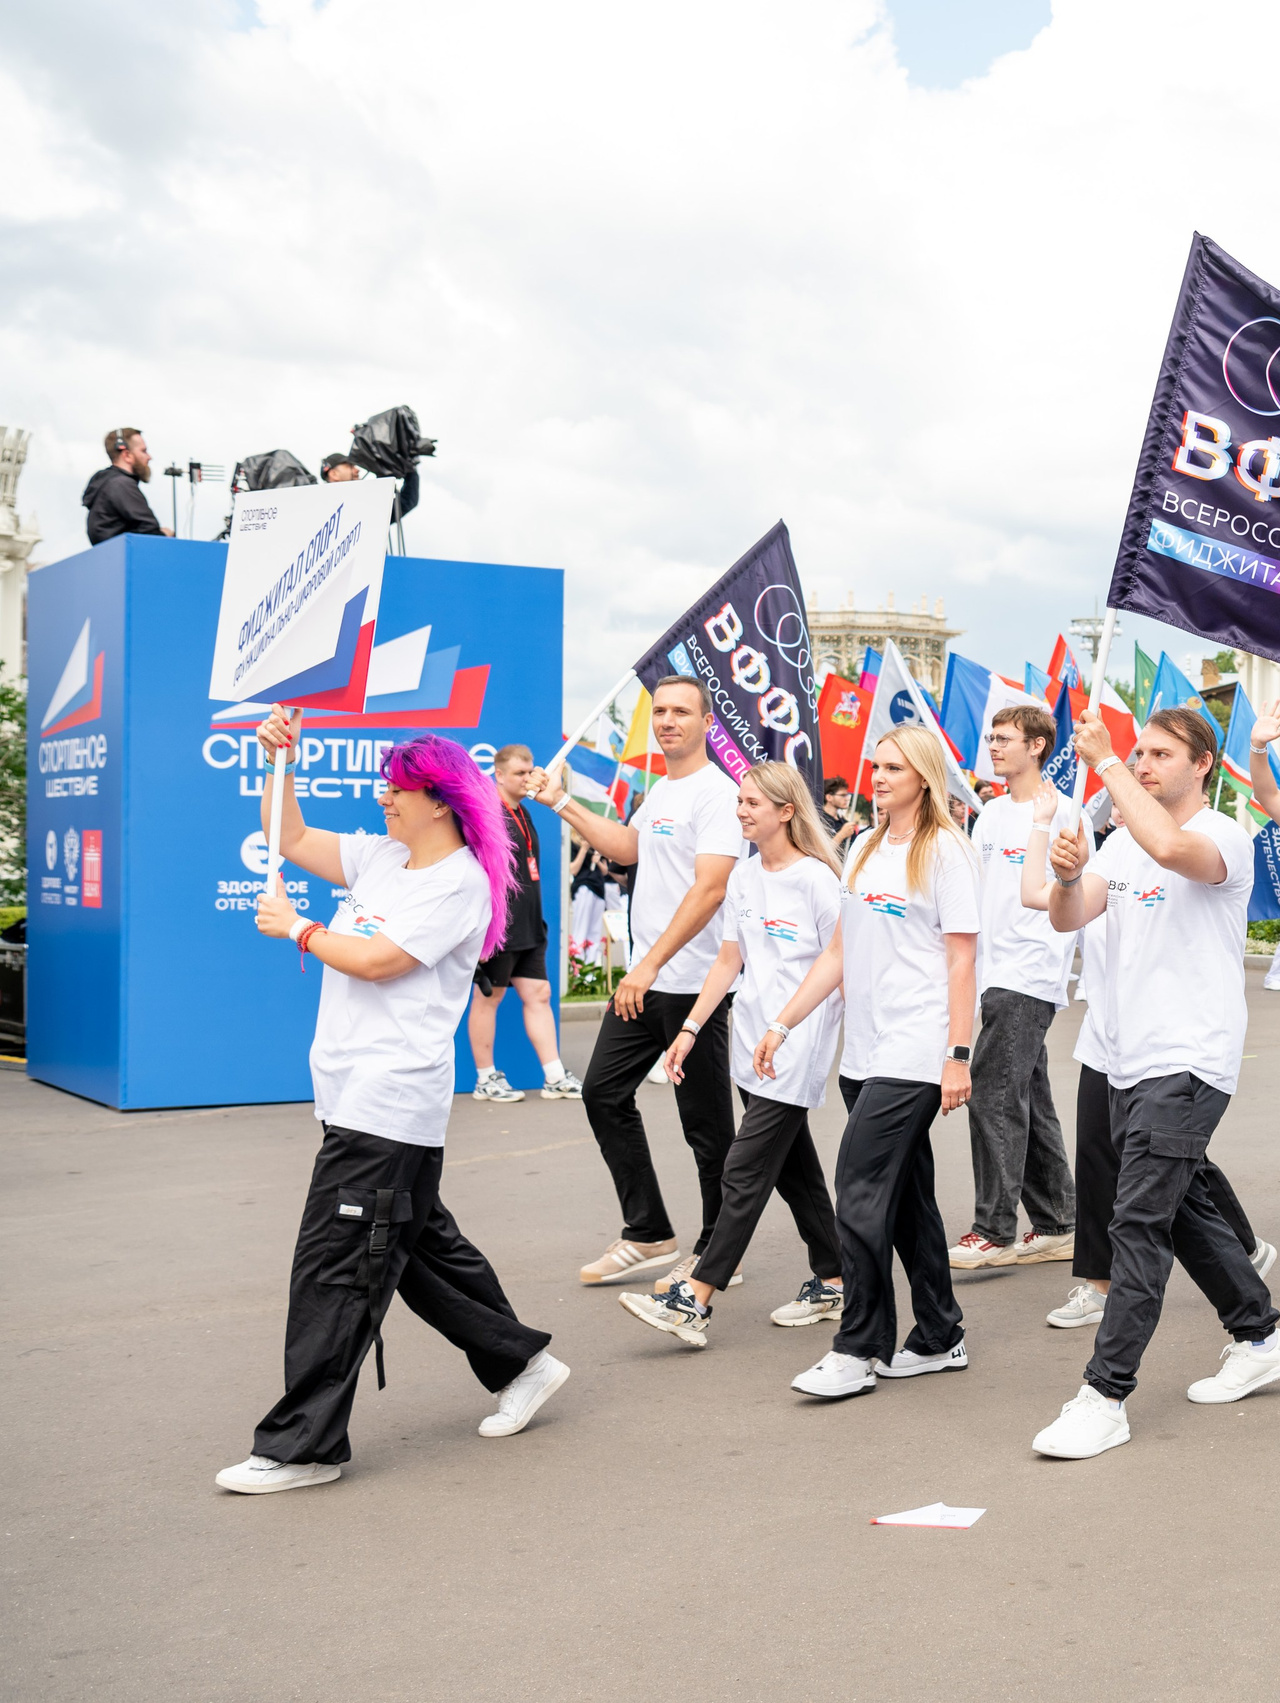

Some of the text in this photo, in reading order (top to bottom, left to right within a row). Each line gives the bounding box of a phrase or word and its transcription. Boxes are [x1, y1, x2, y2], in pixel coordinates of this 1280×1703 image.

[239, 522, 267, 532] ШЕСТВИЕ
[238, 502, 344, 652] ФИДЖИТАЛ СПОРТ
[687, 634, 769, 763] ВСЕРОССИЙСКА
[45, 775, 98, 798] ШЕСТВИЕ
